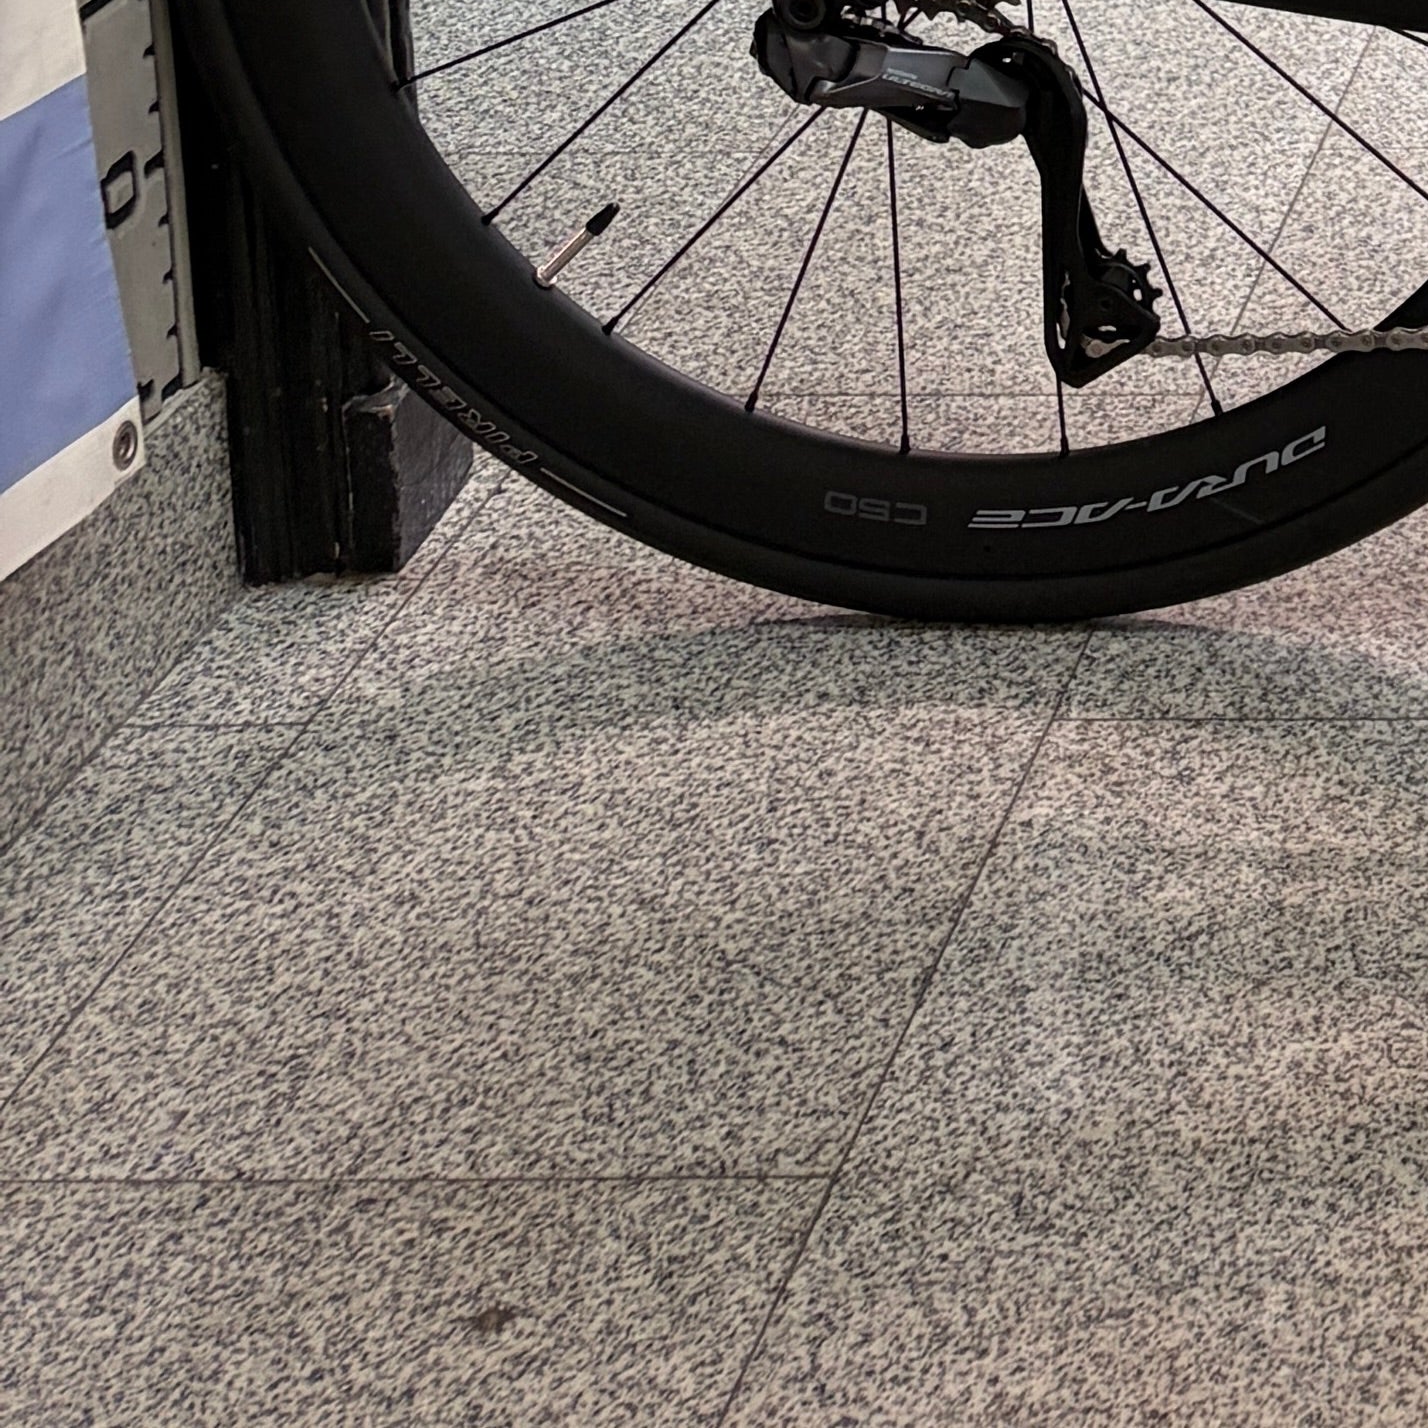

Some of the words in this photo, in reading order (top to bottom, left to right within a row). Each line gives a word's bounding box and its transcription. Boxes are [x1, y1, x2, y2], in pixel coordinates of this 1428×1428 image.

[369, 330, 538, 465] PIRELLI
[824, 490, 927, 525] C50
[967, 425, 1327, 529] DURA-ACE
